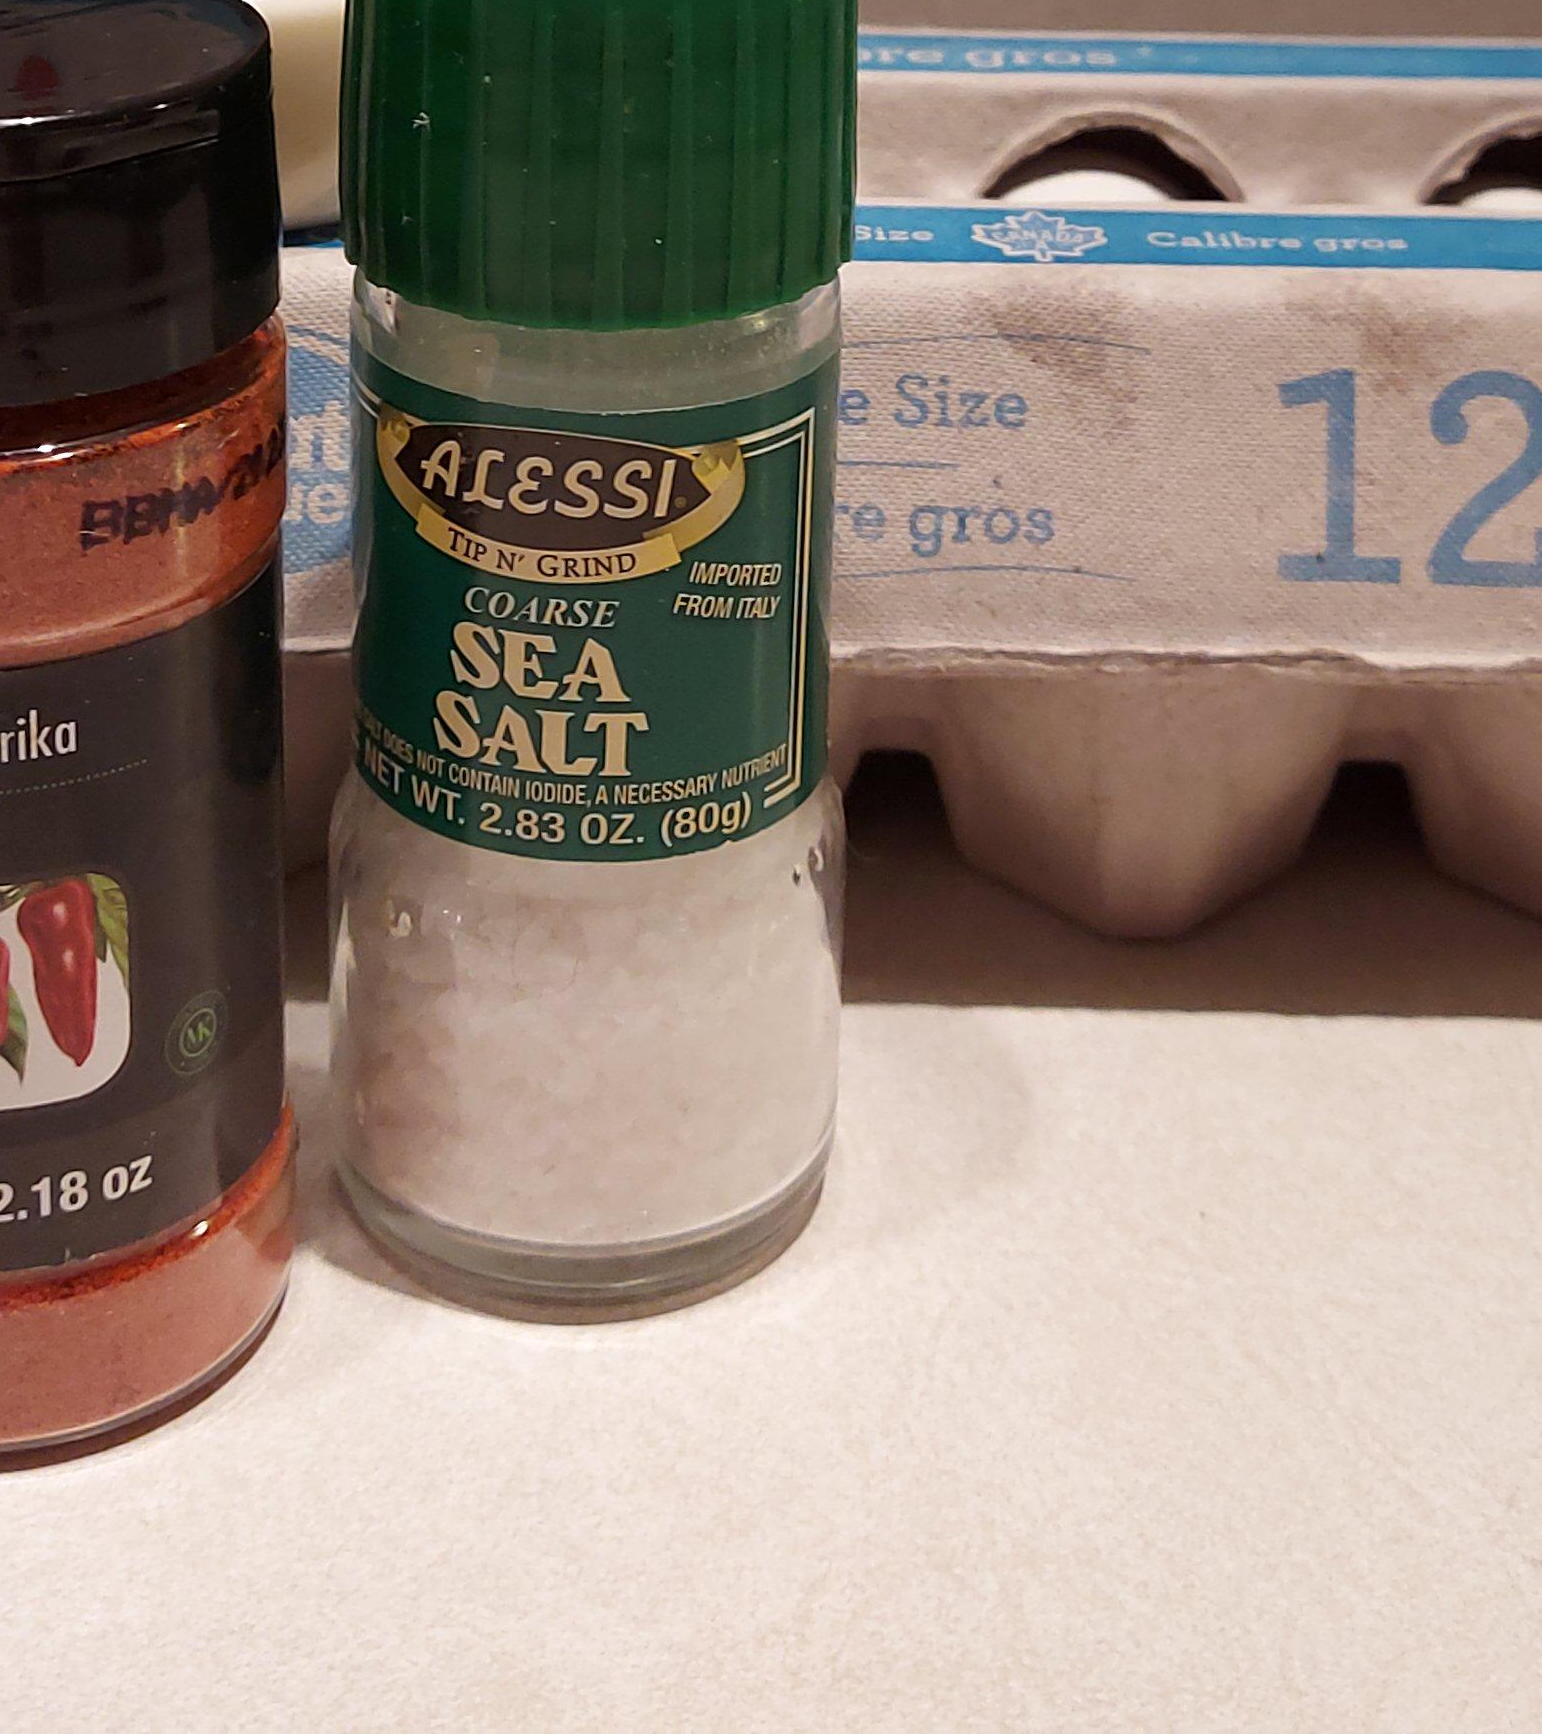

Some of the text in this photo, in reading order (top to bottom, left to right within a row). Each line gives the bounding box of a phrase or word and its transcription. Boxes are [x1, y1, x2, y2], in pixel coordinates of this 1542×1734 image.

[964, 49, 1118, 69] gros
[853, 224, 935, 243] Size
[1145, 230, 1409, 253] Calibre gros
[893, 373, 1029, 429] Size
[420, 439, 679, 520] ALESSI
[447, 526, 489, 564] TIP
[536, 551, 637, 580] GRIND
[908, 504, 1055, 558] gros
[688, 560, 783, 587] IMPORTED
[462, 585, 621, 630] COARSE
[673, 592, 781, 620] FROM ITALY
[449, 620, 632, 704] SEA
[432, 689, 649, 778] SALT
[364, 736, 753, 848] NET WT. 2.83 OZ. (80g)
[416, 748, 447, 779] NOT
[448, 762, 521, 799] CONTAIN
[525, 783, 591, 808] IODIDE,
[595, 786, 609, 806] A
[614, 776, 716, 807] NECESSARY
[721, 742, 789, 789] NUTRIENT
[102, 1153, 156, 1200] oz
